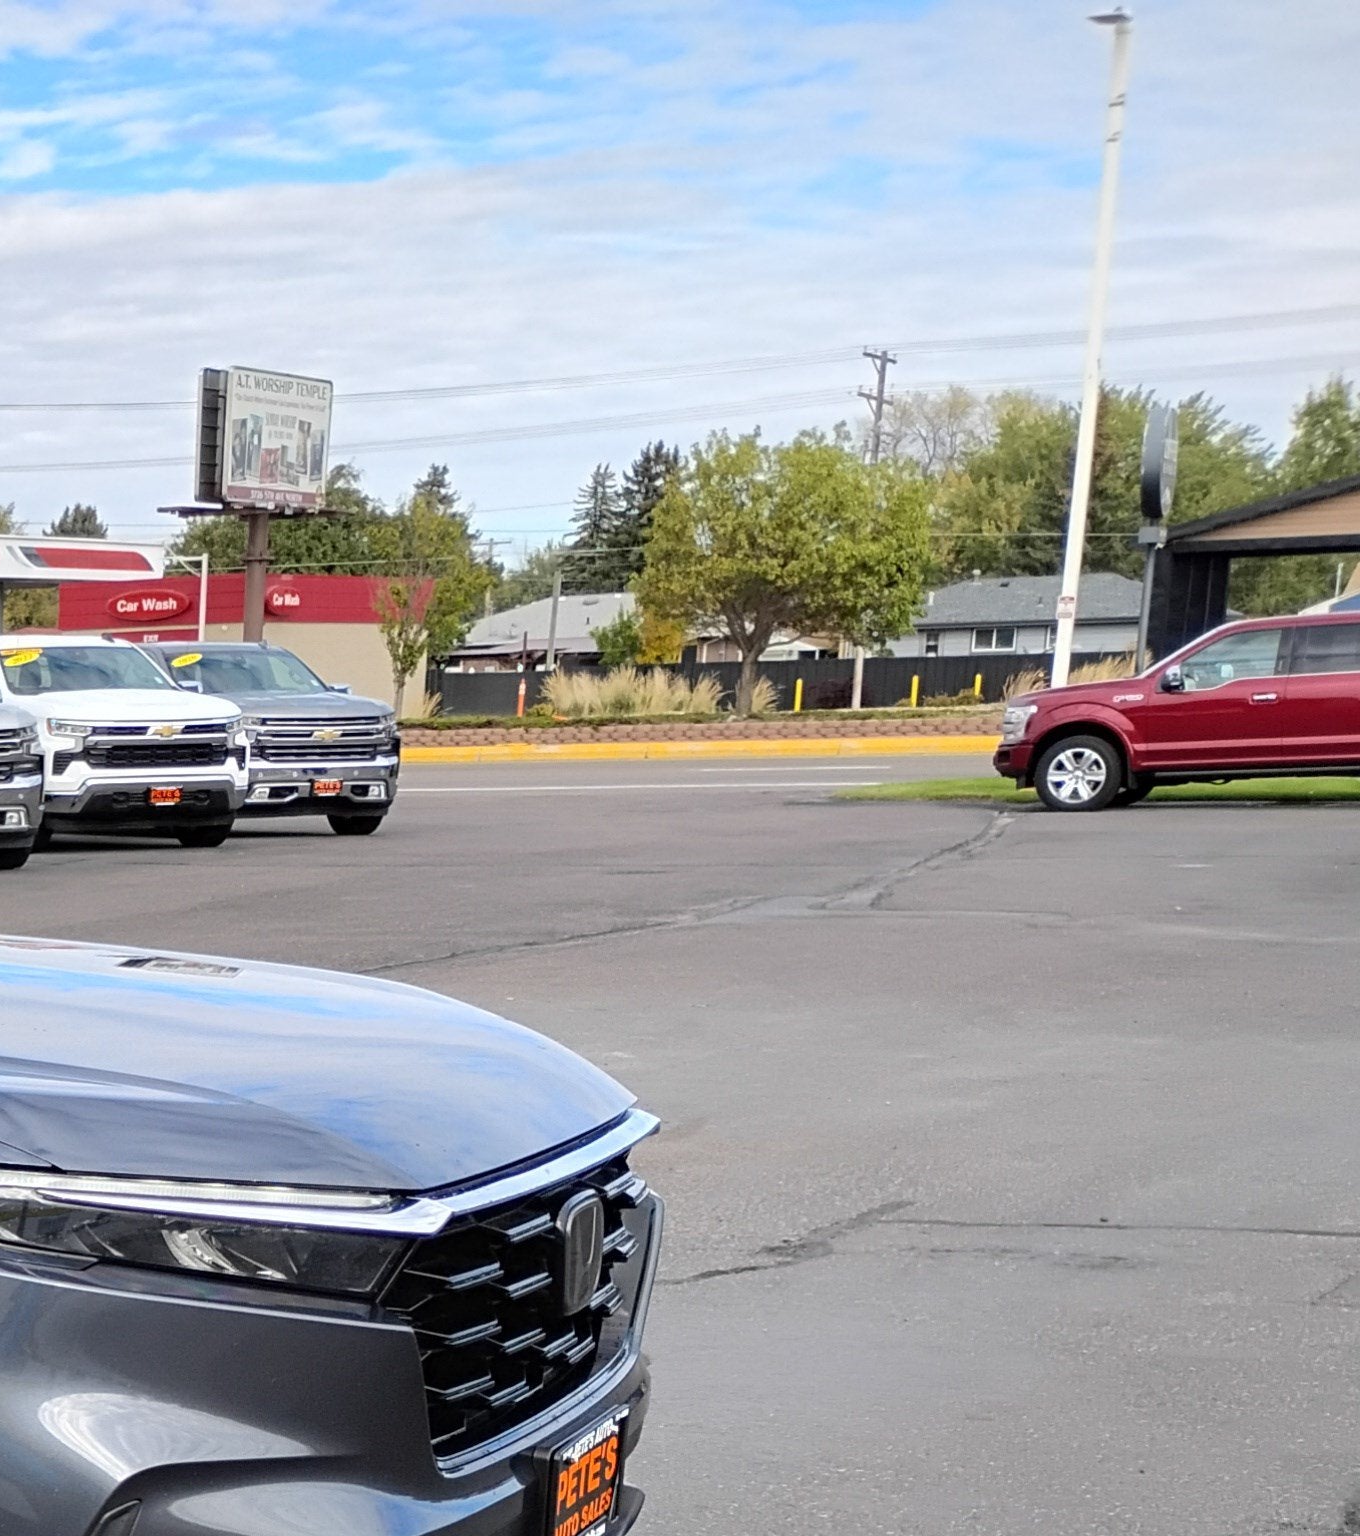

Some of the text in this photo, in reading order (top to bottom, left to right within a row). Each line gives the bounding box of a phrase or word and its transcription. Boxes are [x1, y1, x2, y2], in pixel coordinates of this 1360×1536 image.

[254, 376, 294, 395] WORSHIP
[296, 382, 328, 401] TEMPLE
[116, 597, 177, 613] Car Wash
[273, 593, 300, 606] Car Wash
[556, 1435, 618, 1516] PETE'S
[581, 1487, 613, 1530] SALES
